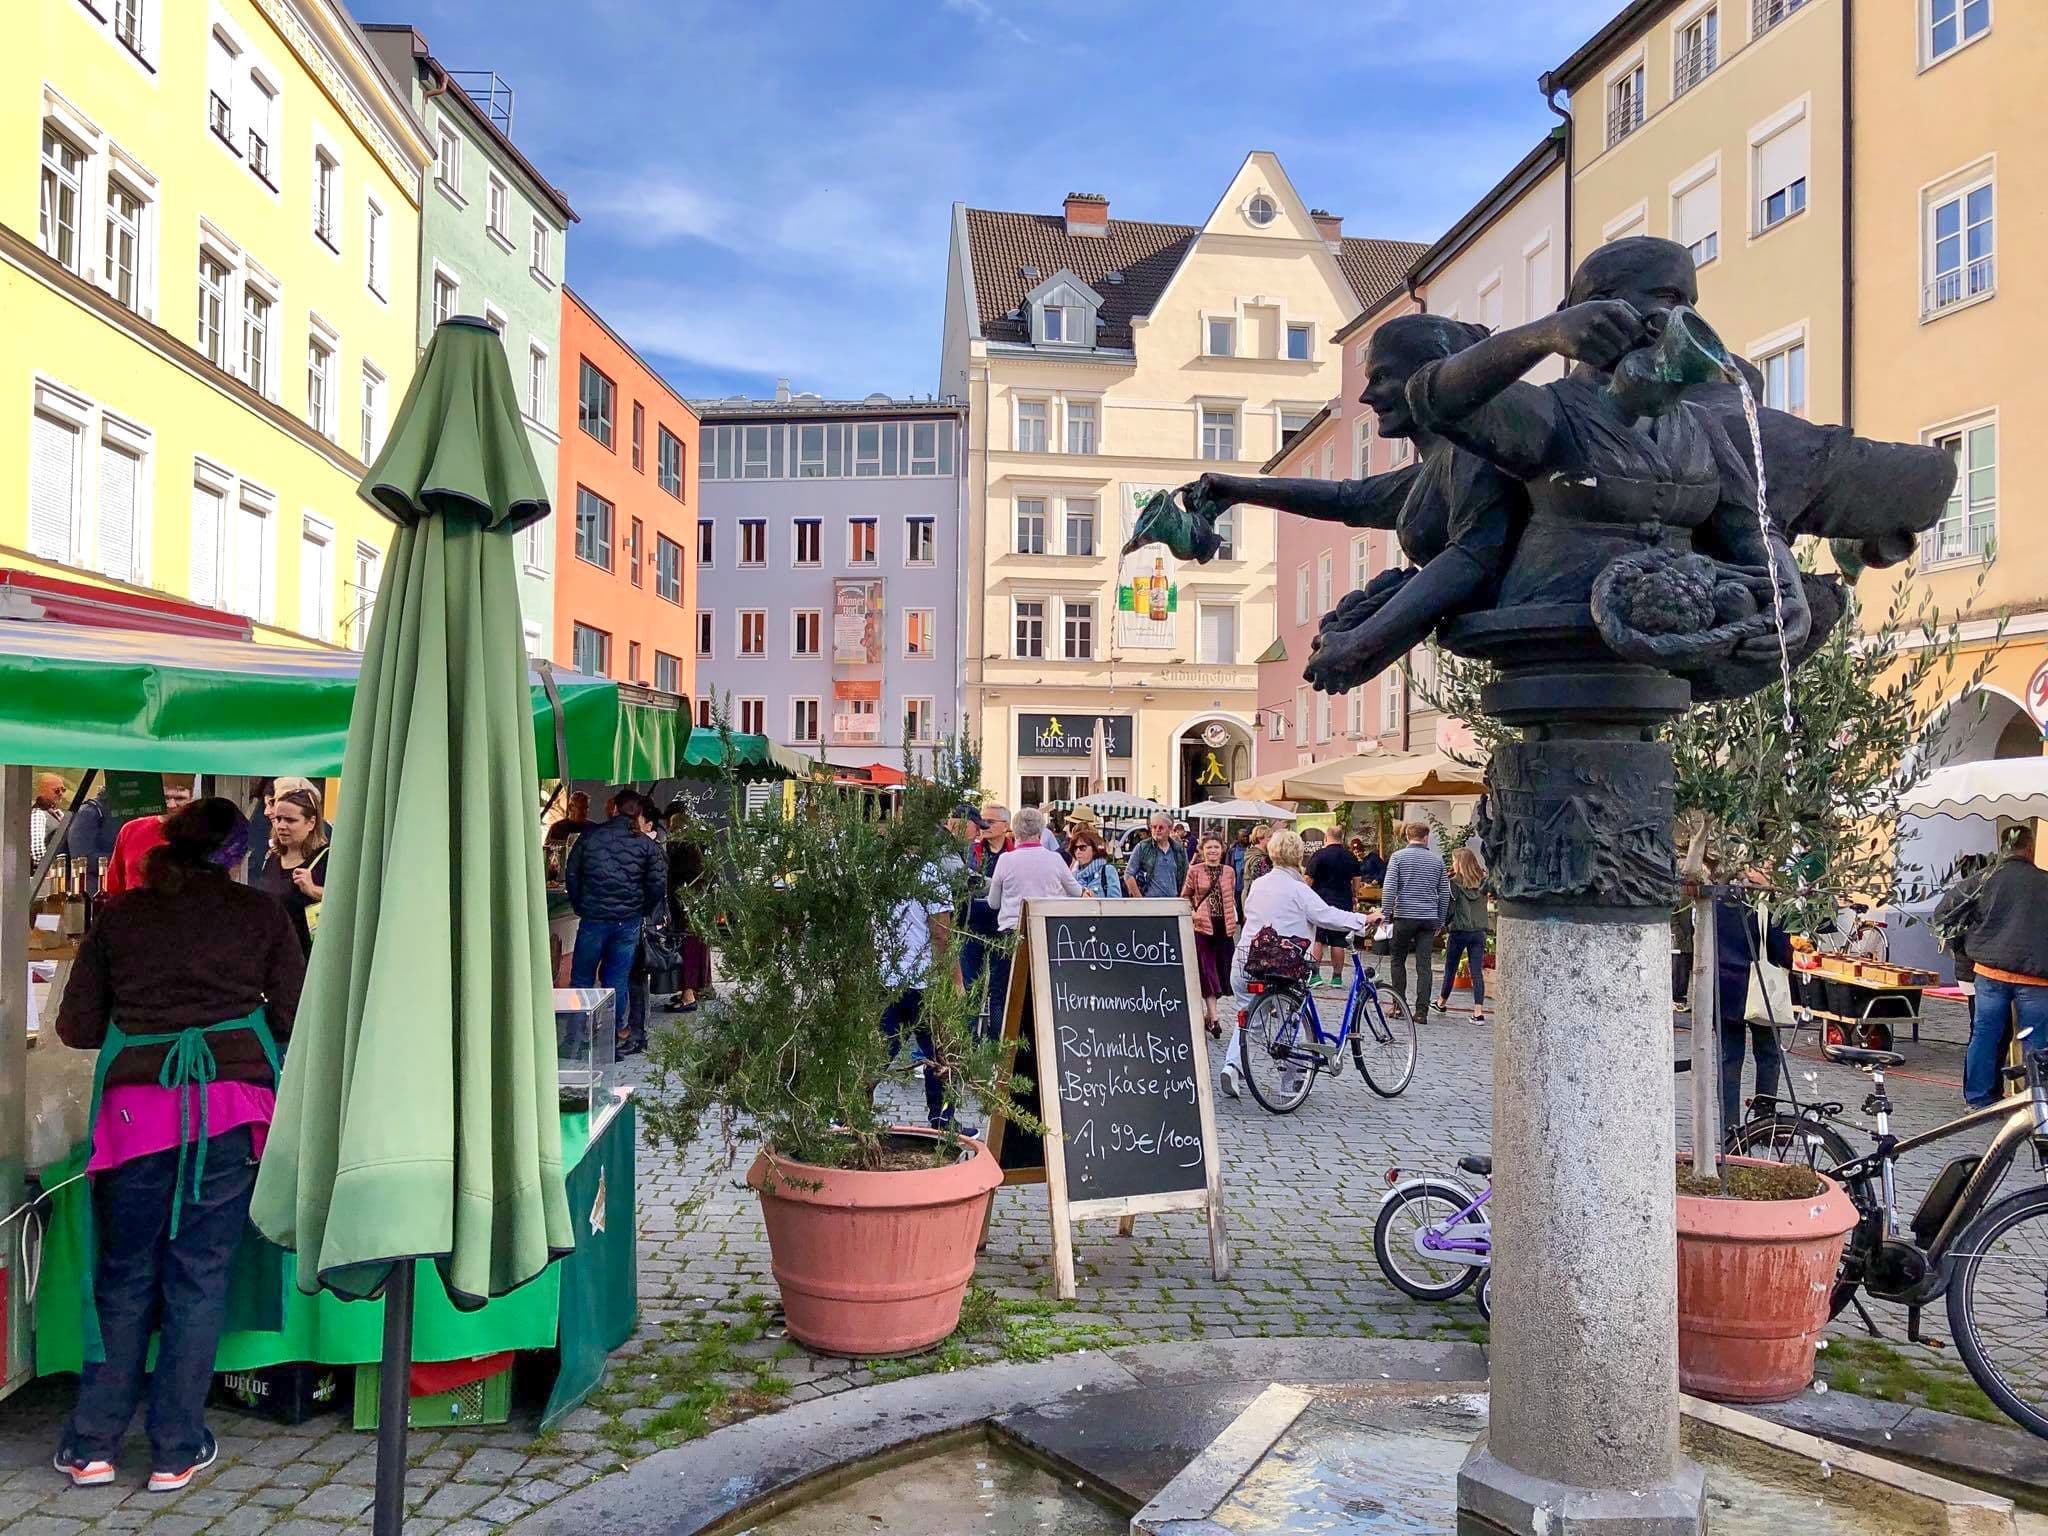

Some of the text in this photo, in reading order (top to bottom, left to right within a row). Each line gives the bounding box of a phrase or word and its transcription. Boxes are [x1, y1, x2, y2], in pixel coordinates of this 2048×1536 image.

[1160, 669, 1237, 685] Ludwigshof
[1035, 726, 1064, 748] hans
[1067, 734, 1082, 748] im
[1057, 1025, 1189, 1064] Rohmilch Brie
[1163, 1069, 1196, 1105] jung
[224, 1374, 270, 1396] WELDE
